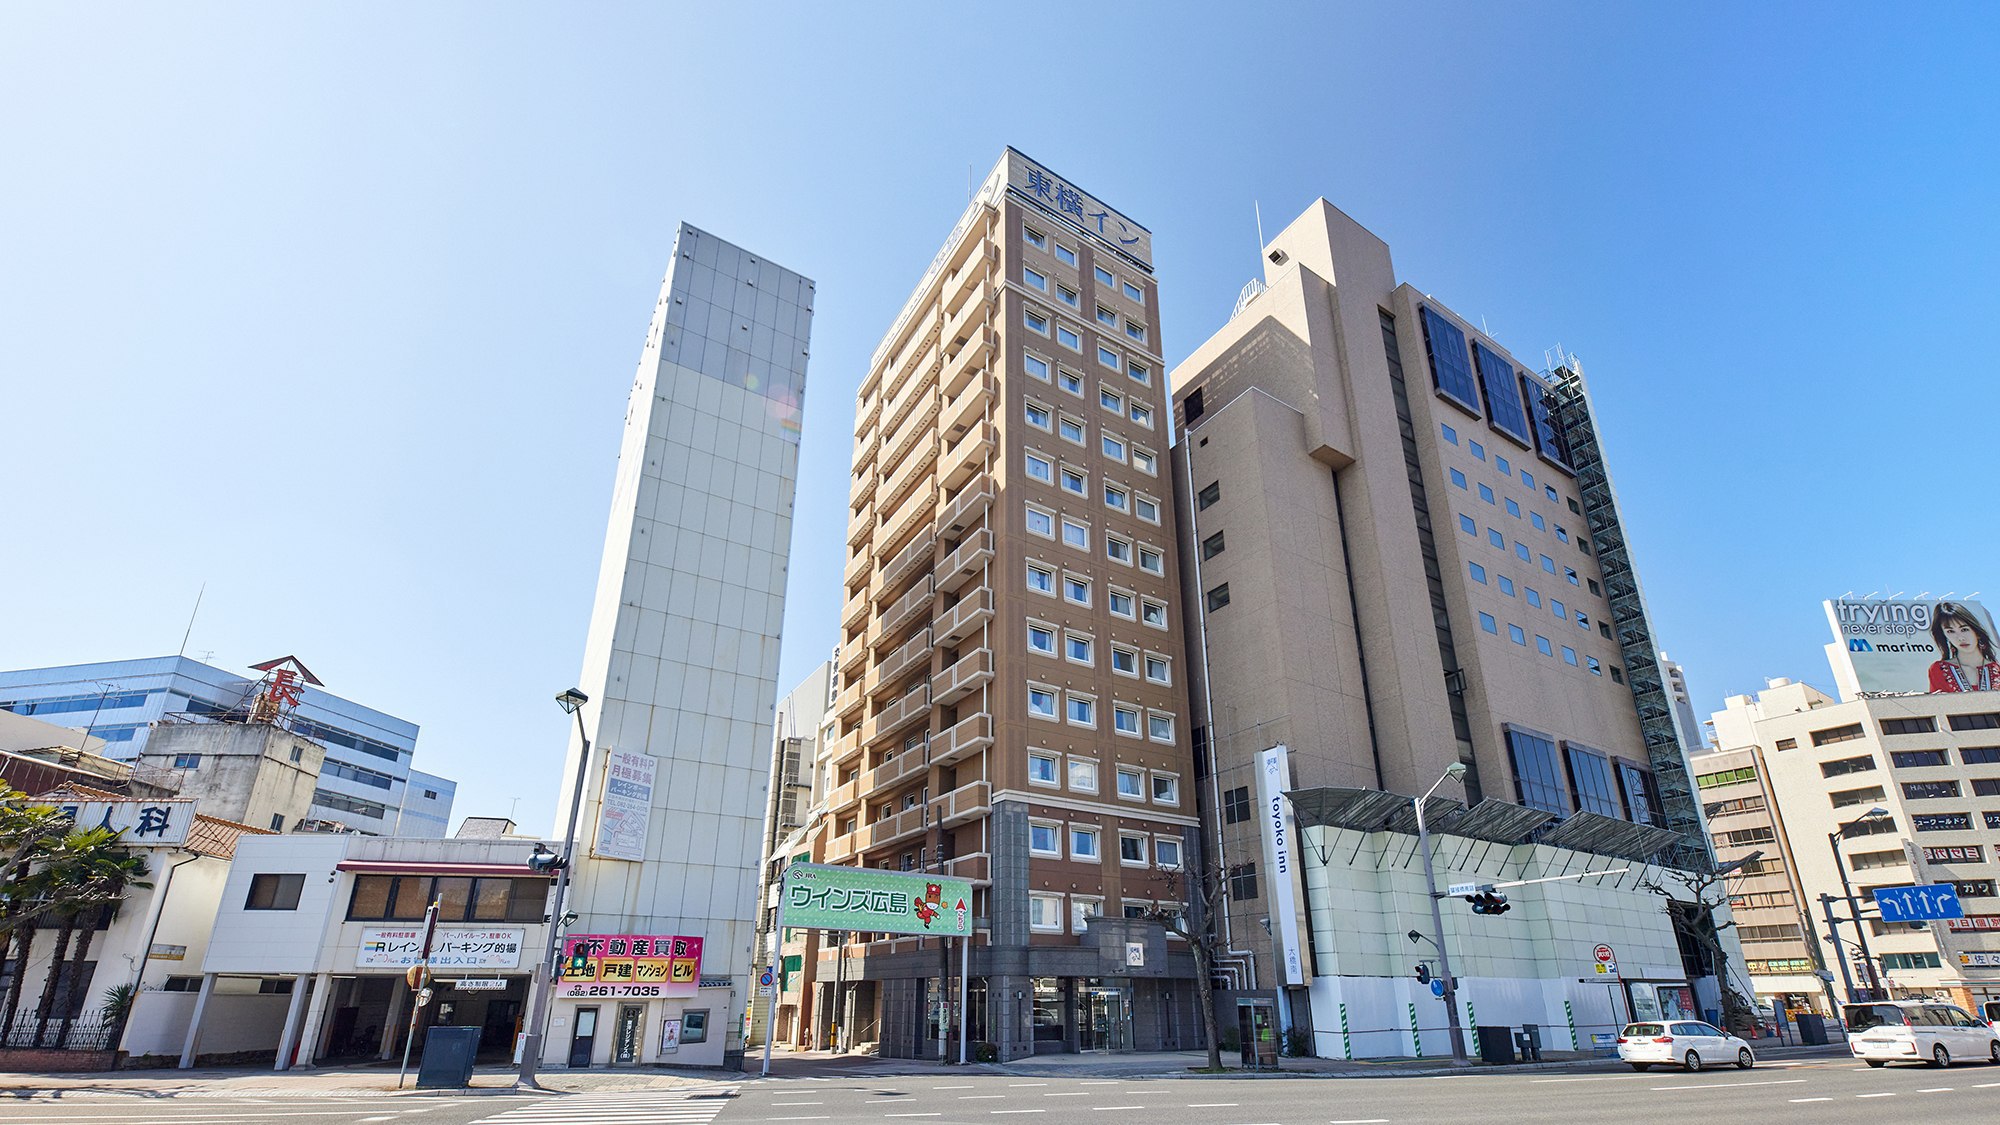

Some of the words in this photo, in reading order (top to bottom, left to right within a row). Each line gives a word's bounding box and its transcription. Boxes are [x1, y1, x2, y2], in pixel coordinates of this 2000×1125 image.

[1024, 165, 1140, 246] 東横イン
[1837, 600, 1932, 631] trying
[1842, 624, 1882, 635] never
[1886, 622, 1916, 638] stop
[1876, 641, 1935, 653] marimo
[268, 669, 305, 707] 長
[1272, 796, 1286, 846] toyoko
[1278, 850, 1287, 874] inn
[791, 885, 907, 914] ウインズ広島
[587, 938, 687, 956] 不動産買取
[565, 963, 595, 977] 土地
[602, 963, 633, 978] 戸建
[637, 965, 668, 978] マンション
[673, 963, 693, 977] ビル
[567, 988, 589, 997] (082)
[589, 985, 660, 997] 261-7035
